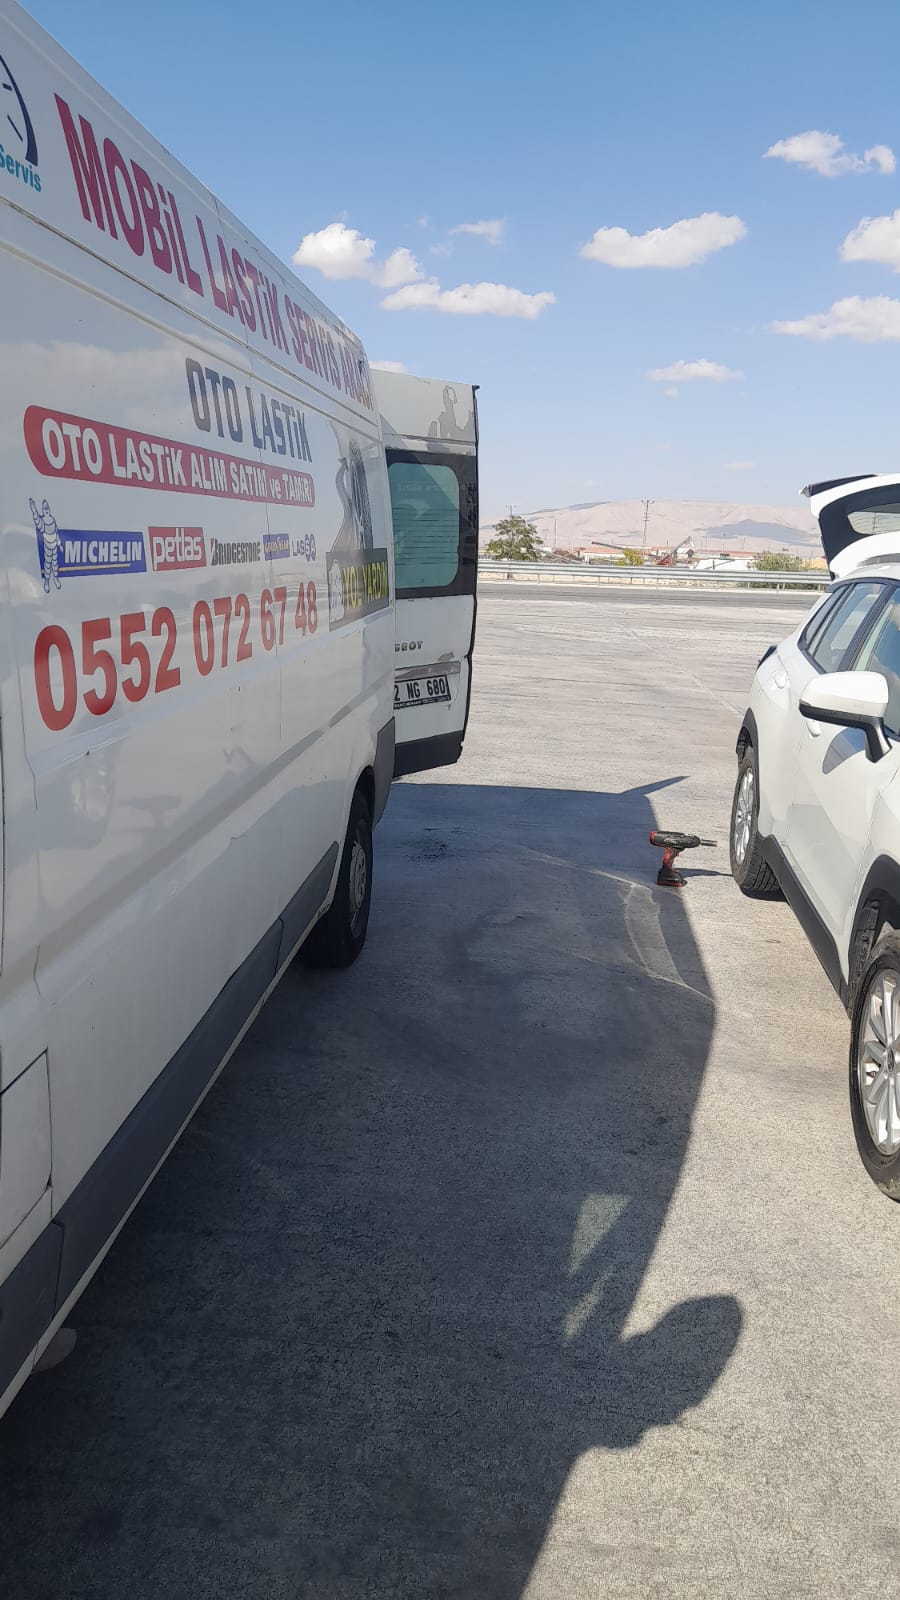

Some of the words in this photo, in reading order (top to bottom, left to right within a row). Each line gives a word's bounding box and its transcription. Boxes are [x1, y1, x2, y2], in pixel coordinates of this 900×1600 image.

[186, 357, 243, 443] OTO
[42, 418, 103, 475] OTO
[190, 452, 228, 492] ALIM
[229, 461, 268, 498] SATIM
[269, 478, 281, 499] ve
[64, 540, 142, 564] MICHELIN
[152, 528, 202, 570] petlas
[211, 538, 261, 566] BRIDGESTONE
[343, 565, 362, 609] YOL
[34, 606, 181, 731] 0552
[192, 593, 252, 676] 072
[260, 586, 287, 651] 67
[295, 580, 317, 636] 48
[407, 682, 420, 699] NG
[427, 678, 445, 696] 680
